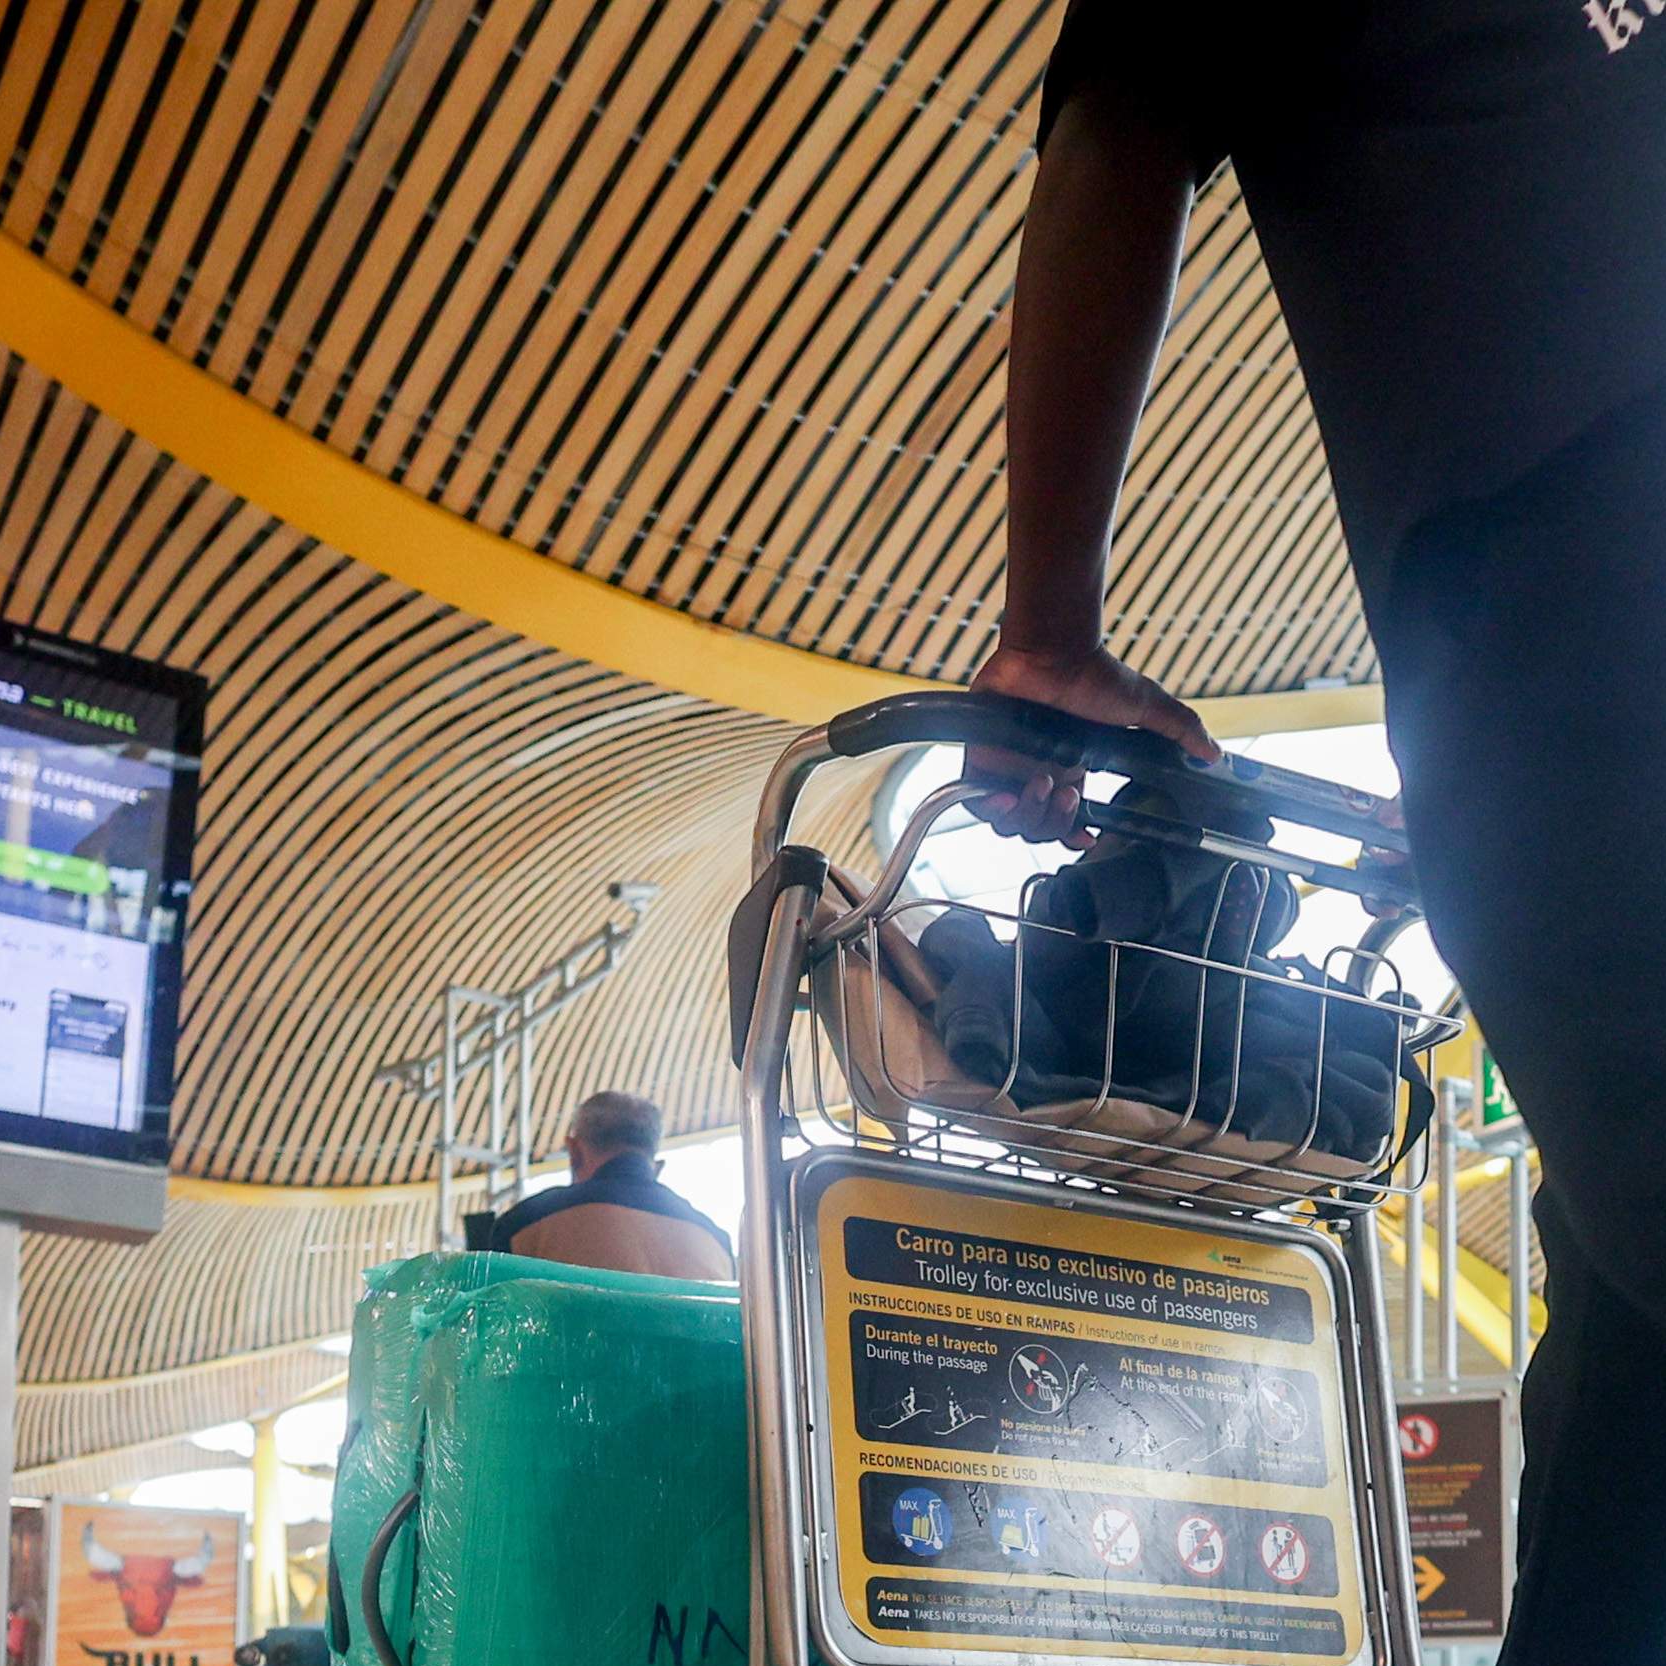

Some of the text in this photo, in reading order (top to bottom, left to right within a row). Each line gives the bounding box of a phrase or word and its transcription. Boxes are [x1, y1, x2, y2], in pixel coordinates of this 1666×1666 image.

[61, 698, 139, 735] TRAVEL
[895, 1227, 1271, 1307] Carro para uso exclusivo de pasajeros
[914, 1259, 1259, 1331] Trolley for exclusive use of passengers
[848, 1290, 953, 1318] INSTRUCCIONES
[956, 1306, 973, 1321] DE
[976, 1308, 1002, 1324] USO
[1005, 1312, 1023, 1327] EN
[1026, 1315, 1076, 1335] RAMPAS
[1085, 1326, 1146, 1344] Instructions
[1148, 1333, 1160, 1346] of
[1161, 1335, 1181, 1349] use
[864, 1323, 999, 1356] Durante el trayecto
[865, 1343, 989, 1376] During the passage
[1119, 1357, 1241, 1389] Al final de la rampa
[1120, 1375, 1247, 1405] At the end of the ramp
[859, 1452, 988, 1477] RECOMENDACIONES
[991, 1465, 1010, 1479] DE
[1012, 1468, 1038, 1482] USO
[876, 1589, 910, 1603] Aena
[877, 1605, 910, 1619] Aena
[913, 1608, 942, 1621] TAKES
[942, 1610, 956, 1621] NO
[1024, 1615, 1035, 1625] OF
[1131, 1622, 1162, 1634] CAUSED
[1162, 1624, 1174, 1635] BY
[1174, 1625, 1189, 1636] THE
[1190, 1626, 1218, 1638] MISUSE
[1219, 1628, 1230, 1639] OF
[1231, 1629, 1249, 1640] THIS
[1249, 1630, 1281, 1642] TROLLEY
